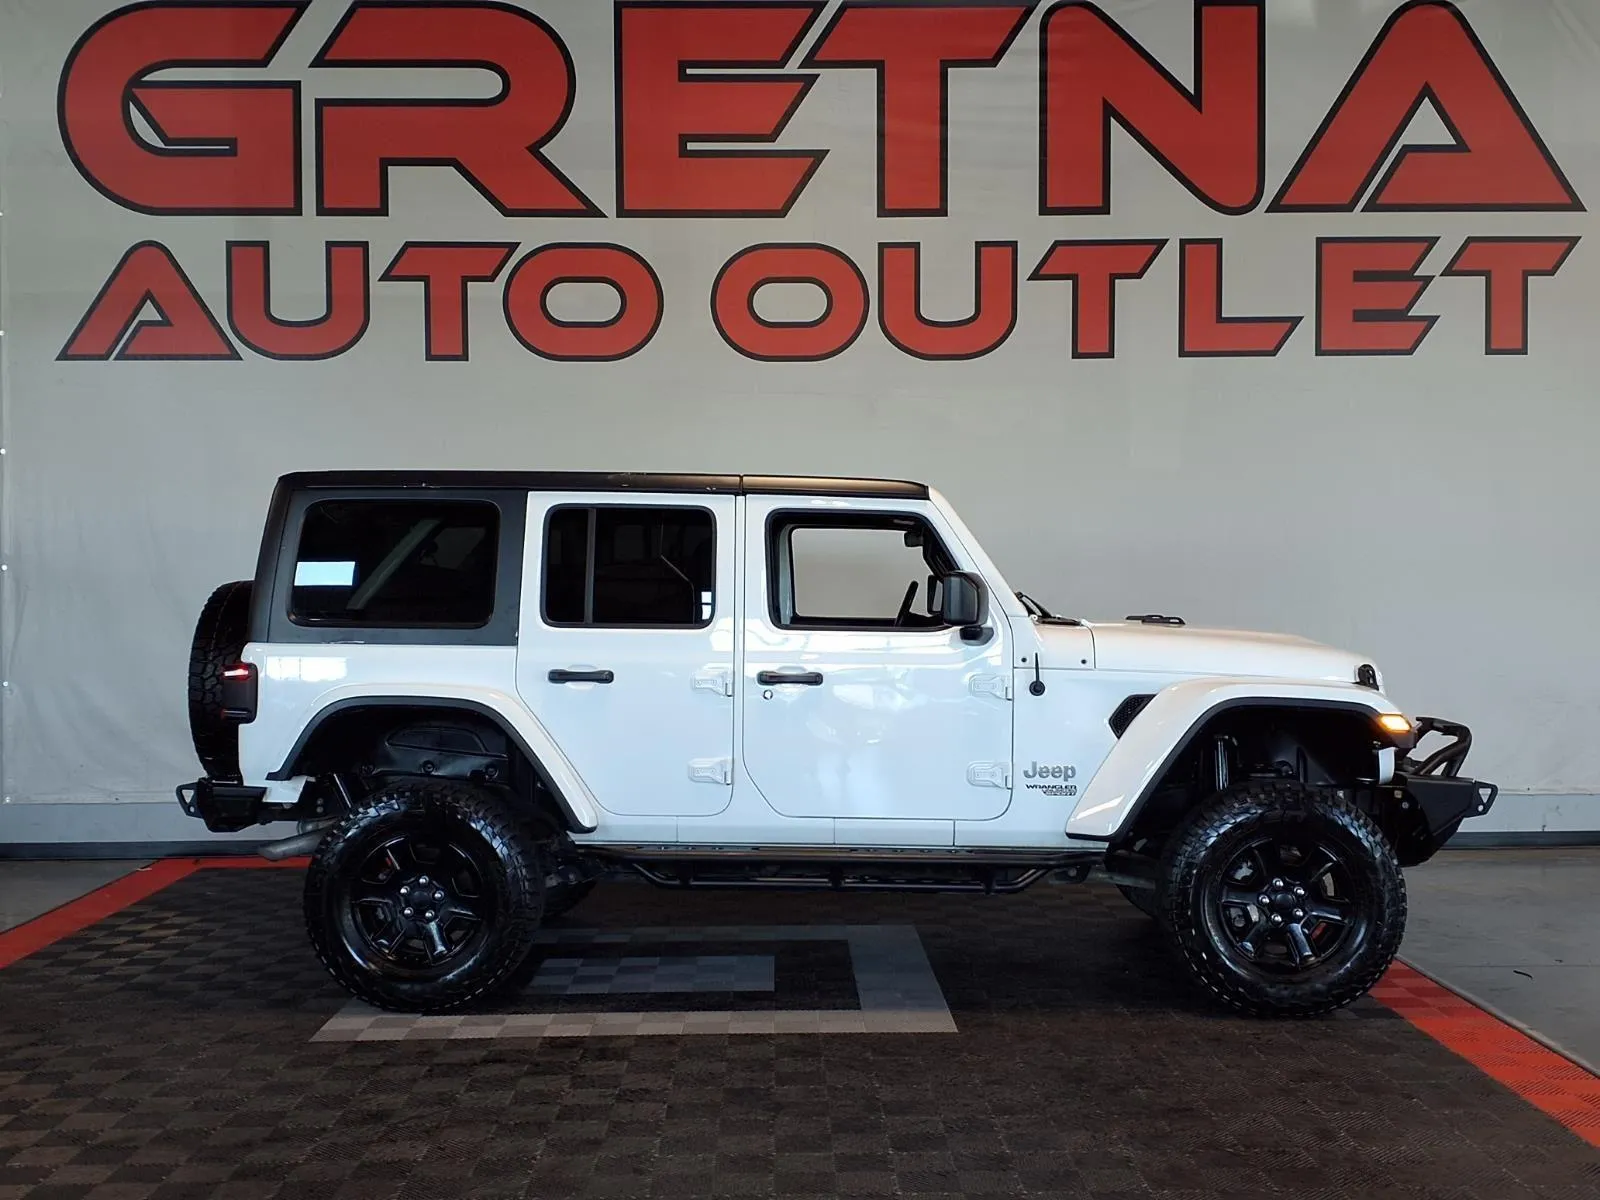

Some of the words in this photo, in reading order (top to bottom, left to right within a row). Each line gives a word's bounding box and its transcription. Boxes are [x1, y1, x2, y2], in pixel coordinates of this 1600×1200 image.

[57, 0, 1588, 218] GRETNA
[55, 239, 664, 362] AUTO
[711, 235, 1582, 362] OUTLET
[1023, 760, 1077, 782] Jeep
